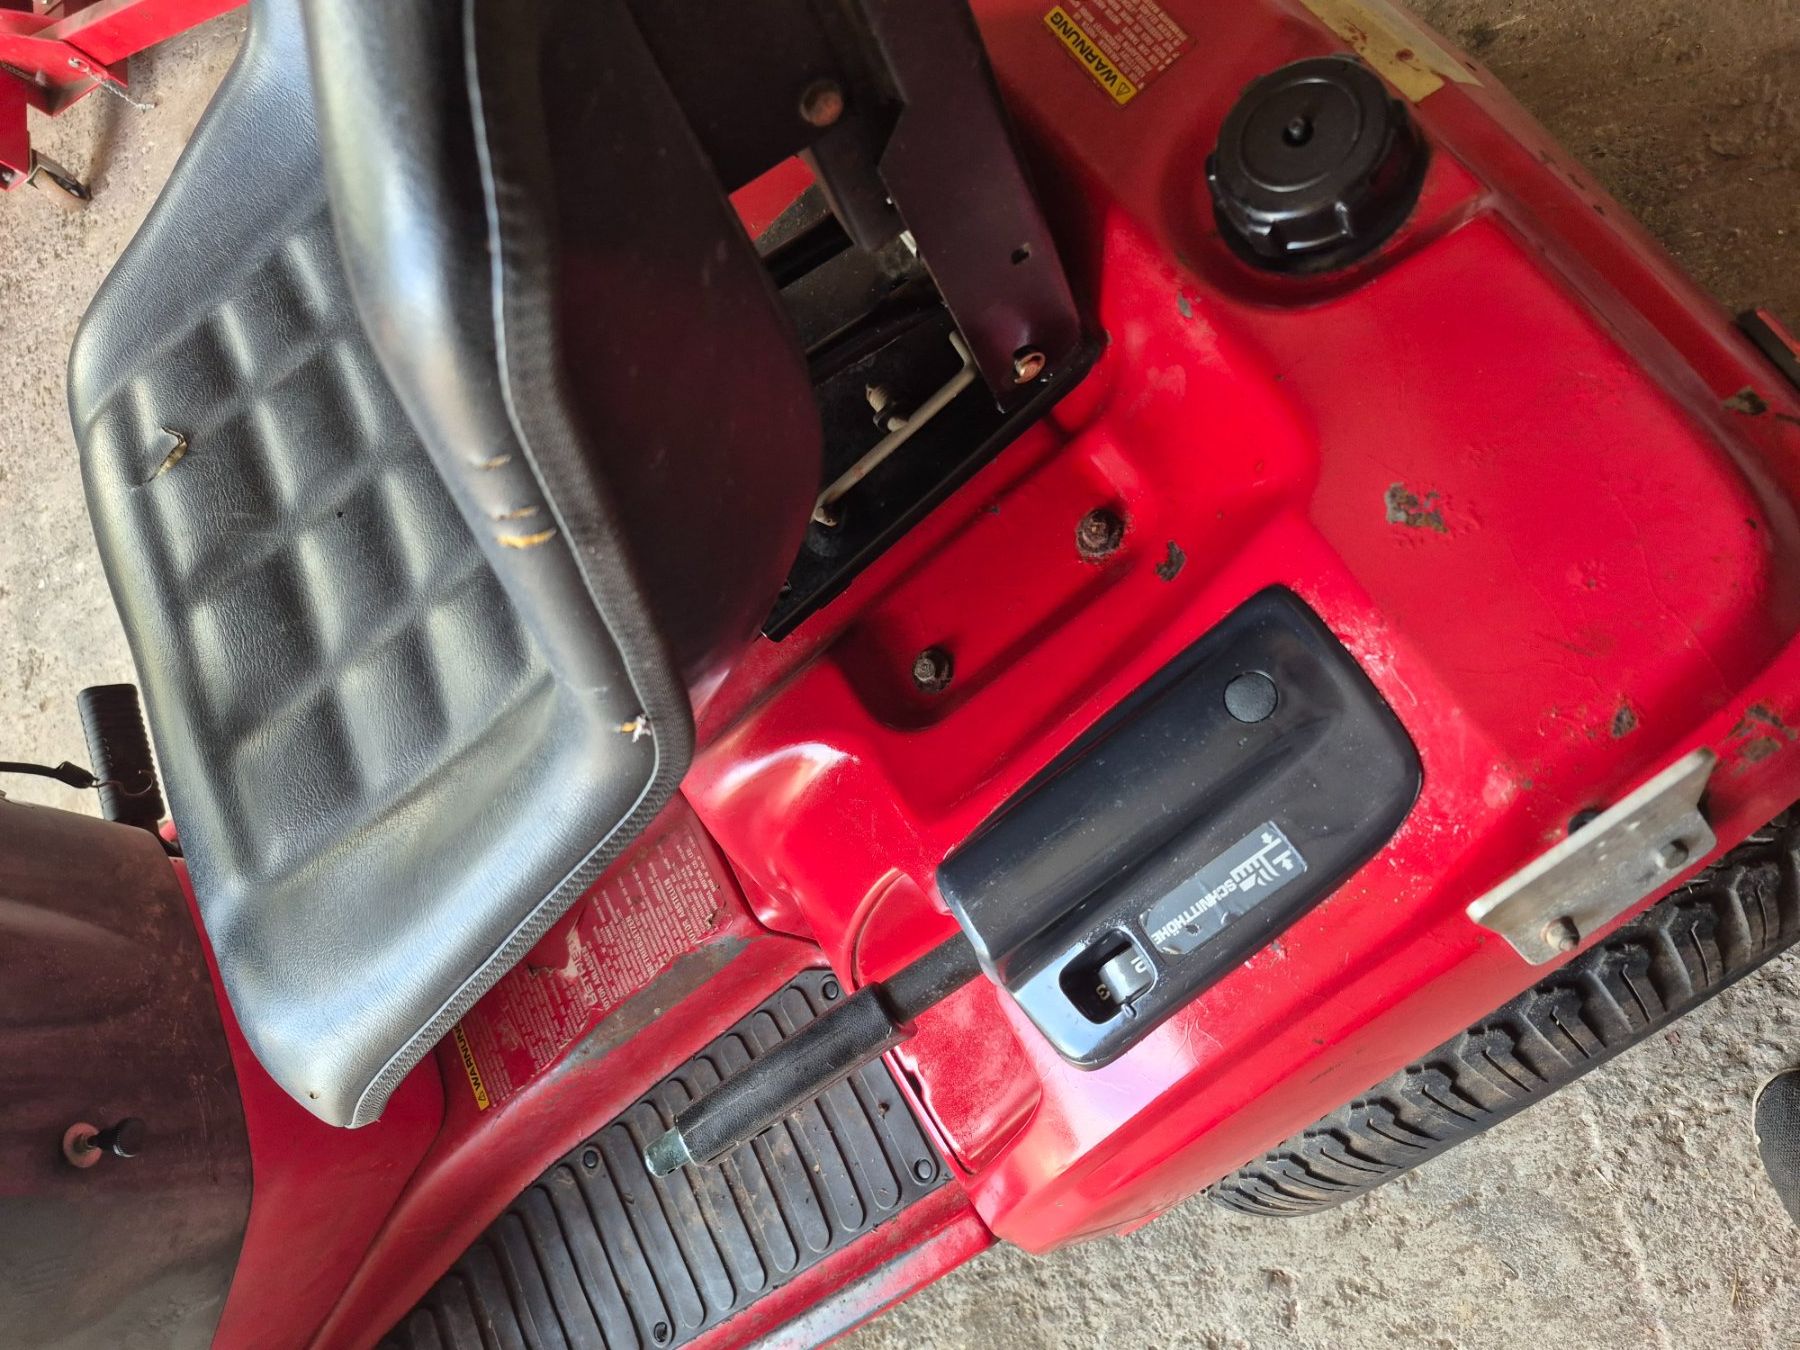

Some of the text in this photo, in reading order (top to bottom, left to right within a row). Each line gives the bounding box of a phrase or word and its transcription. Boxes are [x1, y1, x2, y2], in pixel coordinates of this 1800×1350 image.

[1050, 12, 1116, 86] WARNUNG
[663, 877, 686, 917] ABSTELLEN
[1150, 876, 1238, 946] SCHNITTHÖHE
[580, 945, 601, 985] ANLASSEN
[1131, 955, 1148, 973] 2
[1096, 984, 1110, 1000] 3
